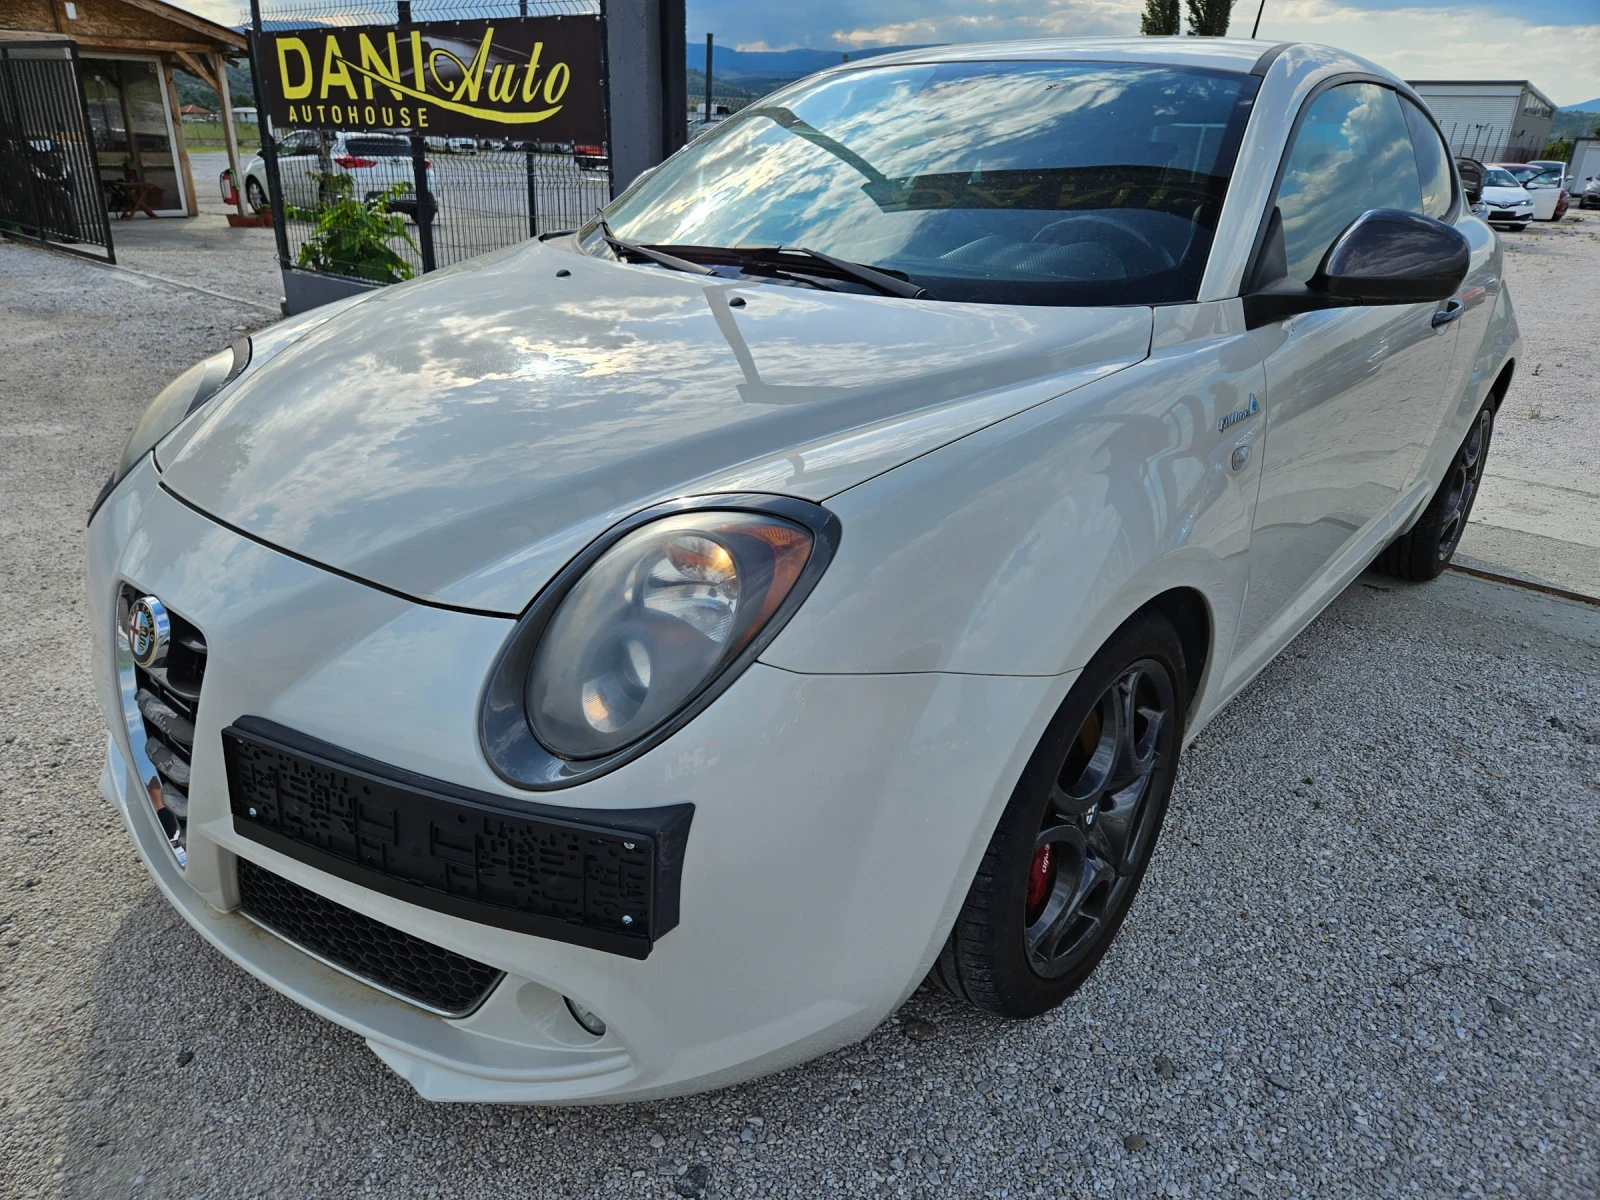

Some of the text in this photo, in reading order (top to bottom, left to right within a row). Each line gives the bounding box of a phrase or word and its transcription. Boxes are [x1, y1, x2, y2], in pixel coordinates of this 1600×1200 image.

[276, 27, 571, 104] DANI Auto
[289, 105, 429, 127] AUTOHOUSE
